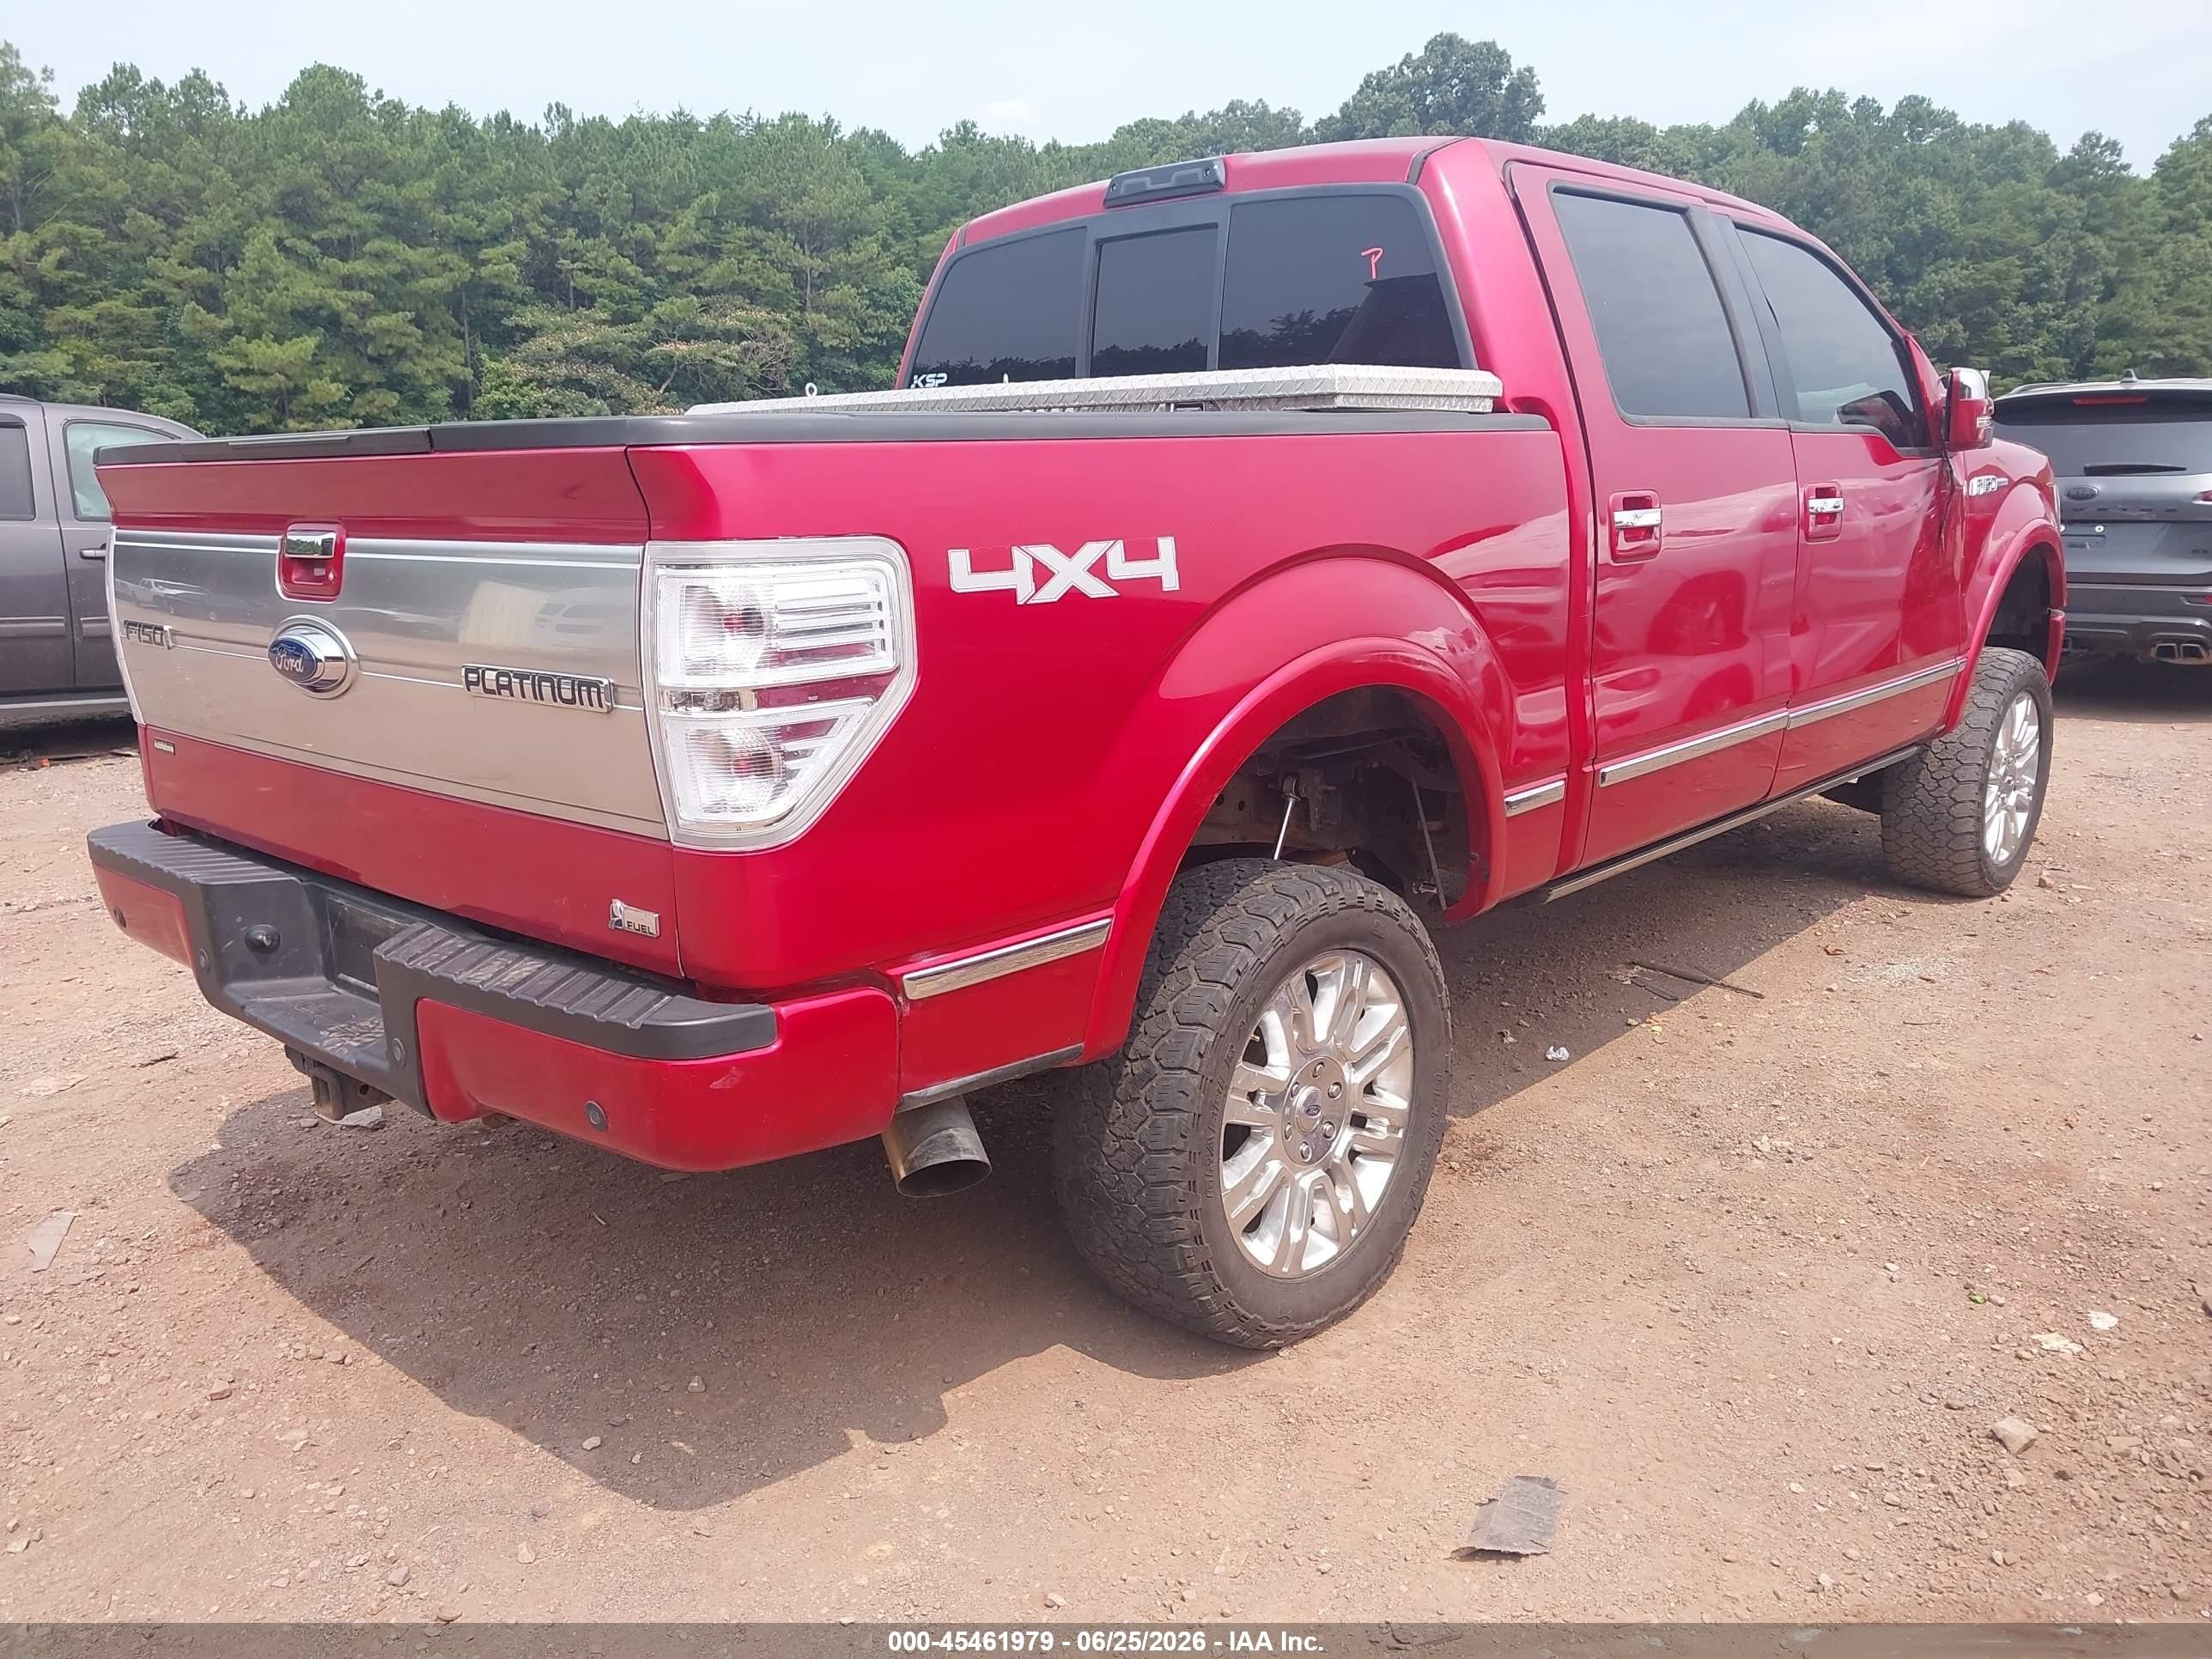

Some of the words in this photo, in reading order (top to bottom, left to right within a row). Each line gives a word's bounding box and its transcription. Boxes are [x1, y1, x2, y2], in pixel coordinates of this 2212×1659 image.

[910, 373, 948, 389] KSP
[272, 642, 305, 673] Ford
[464, 666, 605, 709] PLATINUM
[626, 921, 655, 935] FUEL
